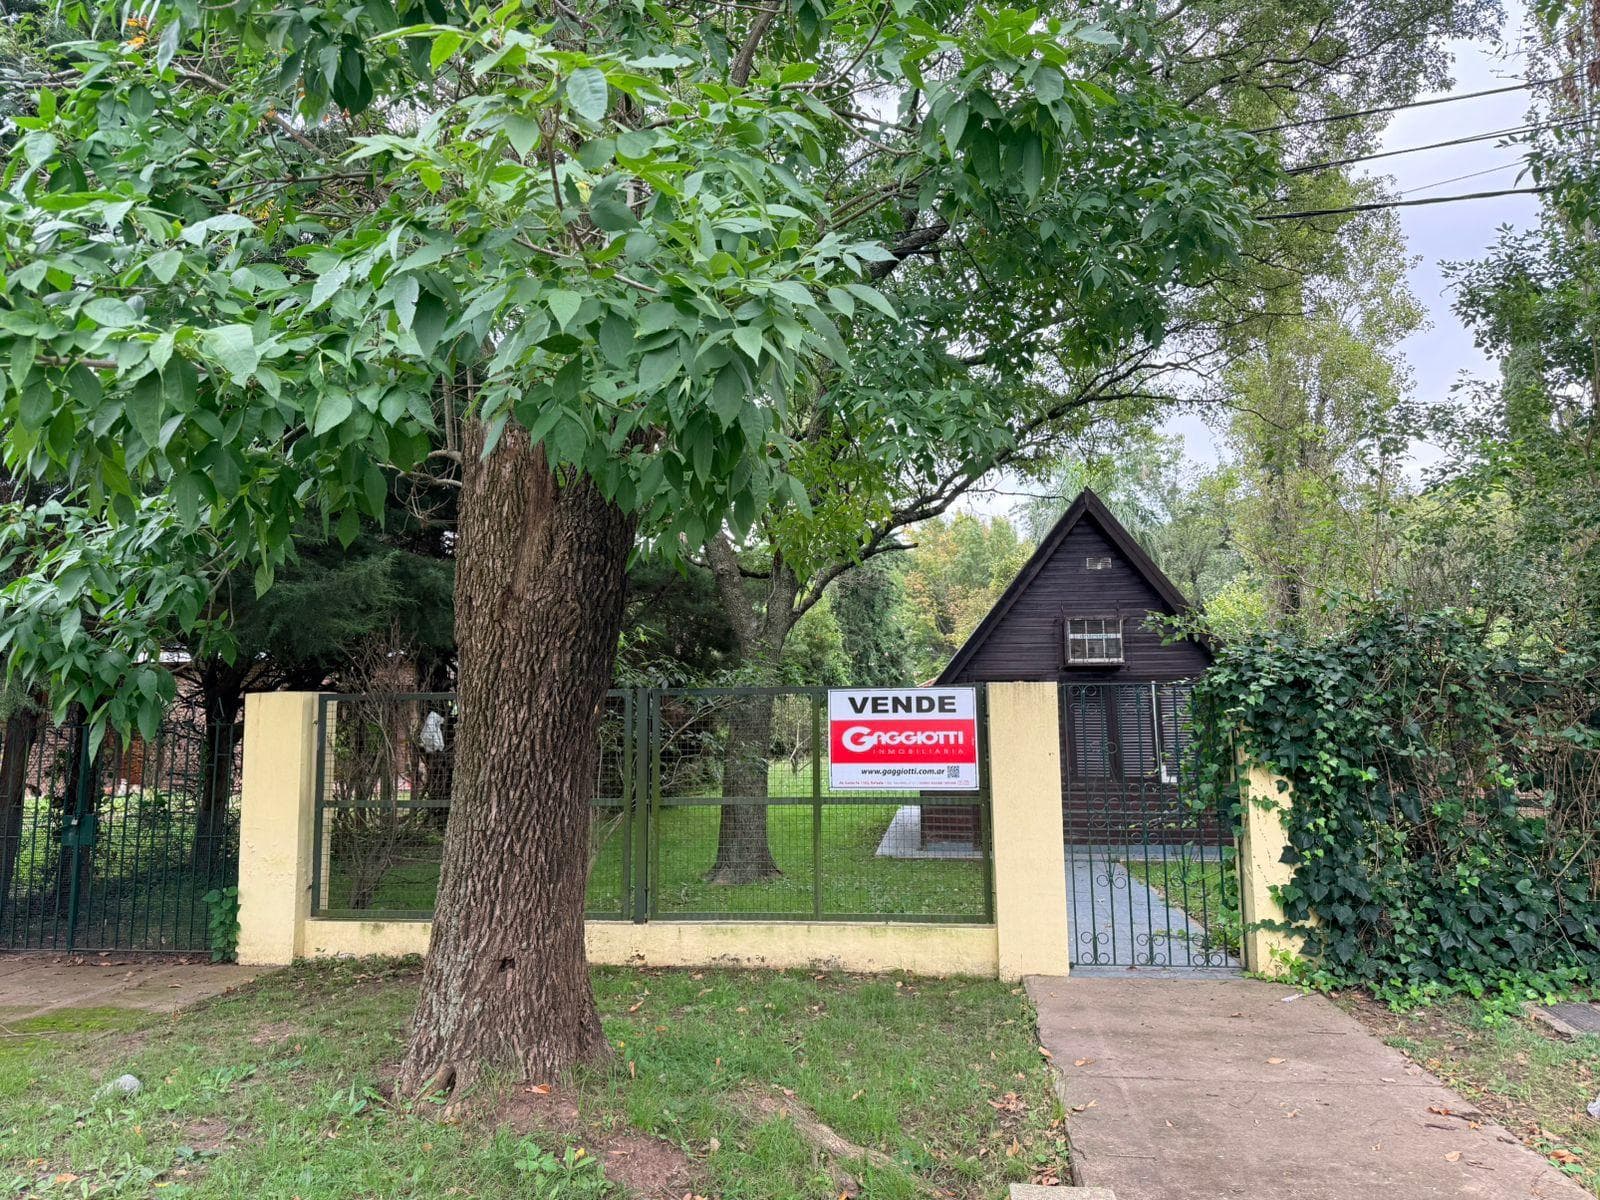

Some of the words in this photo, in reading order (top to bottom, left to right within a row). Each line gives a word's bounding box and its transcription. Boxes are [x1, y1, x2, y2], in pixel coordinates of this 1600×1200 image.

[848, 696, 957, 714] VENDE
[842, 726, 963, 752] GAGGIOTTI
[861, 768, 945, 776] www.gaggiotti.com.ar
